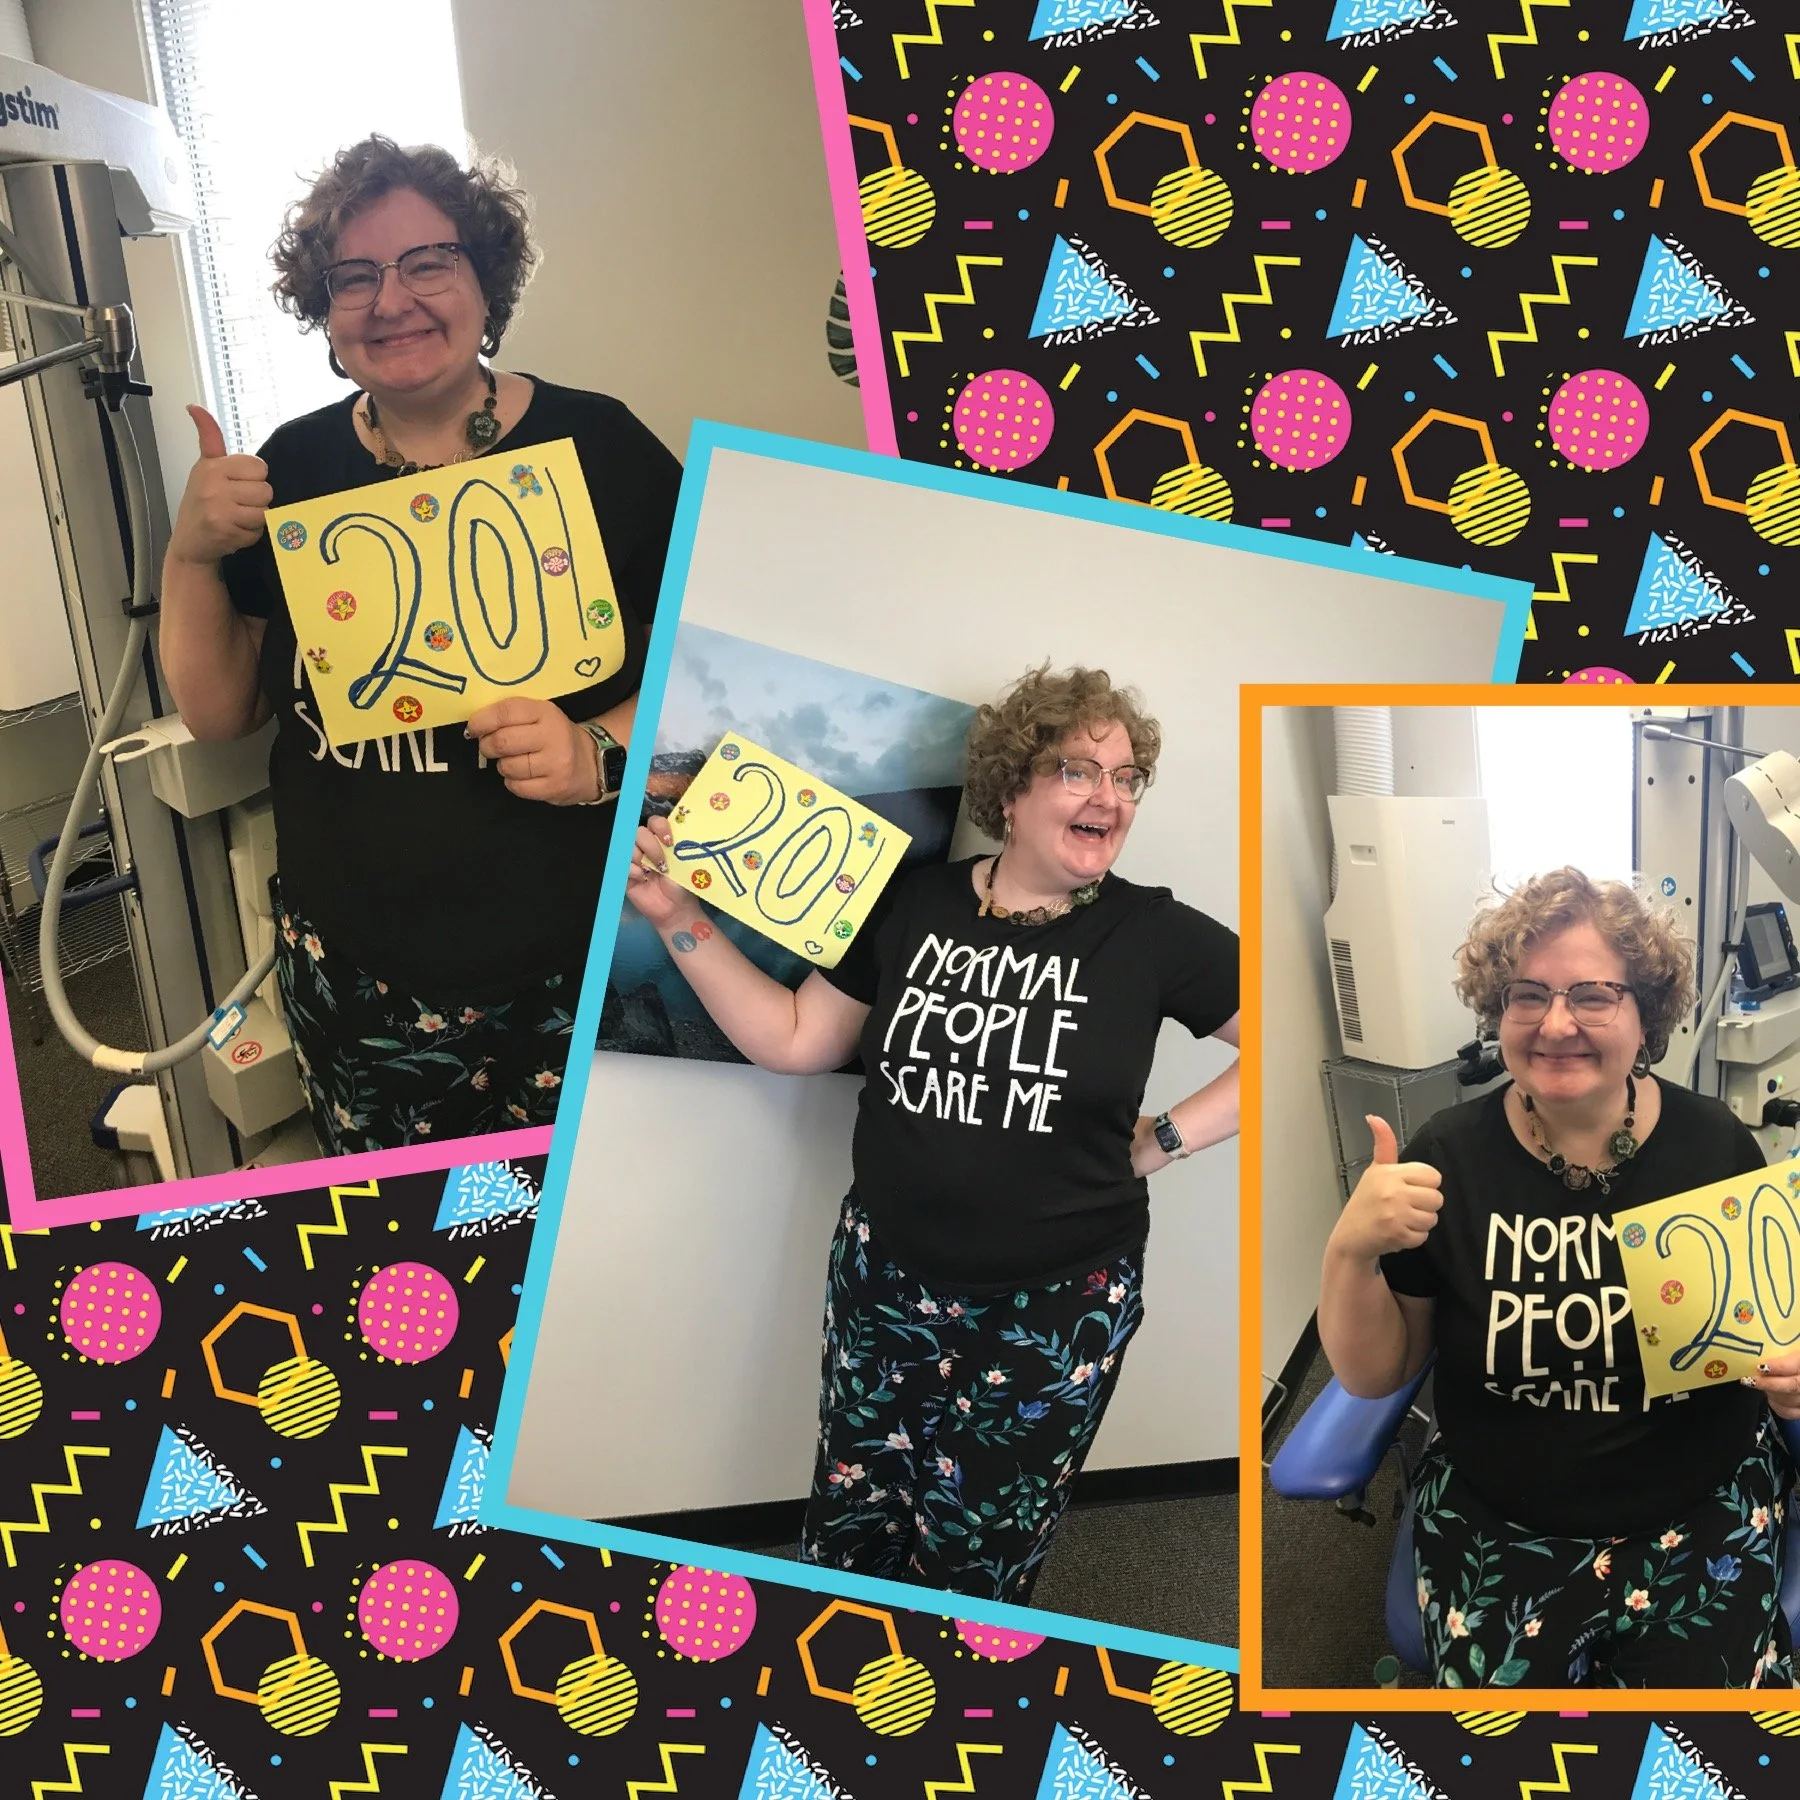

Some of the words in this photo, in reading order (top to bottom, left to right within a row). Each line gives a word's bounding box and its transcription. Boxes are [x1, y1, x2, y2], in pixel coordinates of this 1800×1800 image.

[906, 933, 1089, 1004] NORMAL
[883, 986, 1078, 1078] PEOPLE
[879, 1061, 990, 1126] SCARE
[1002, 1078, 1062, 1133] ME
